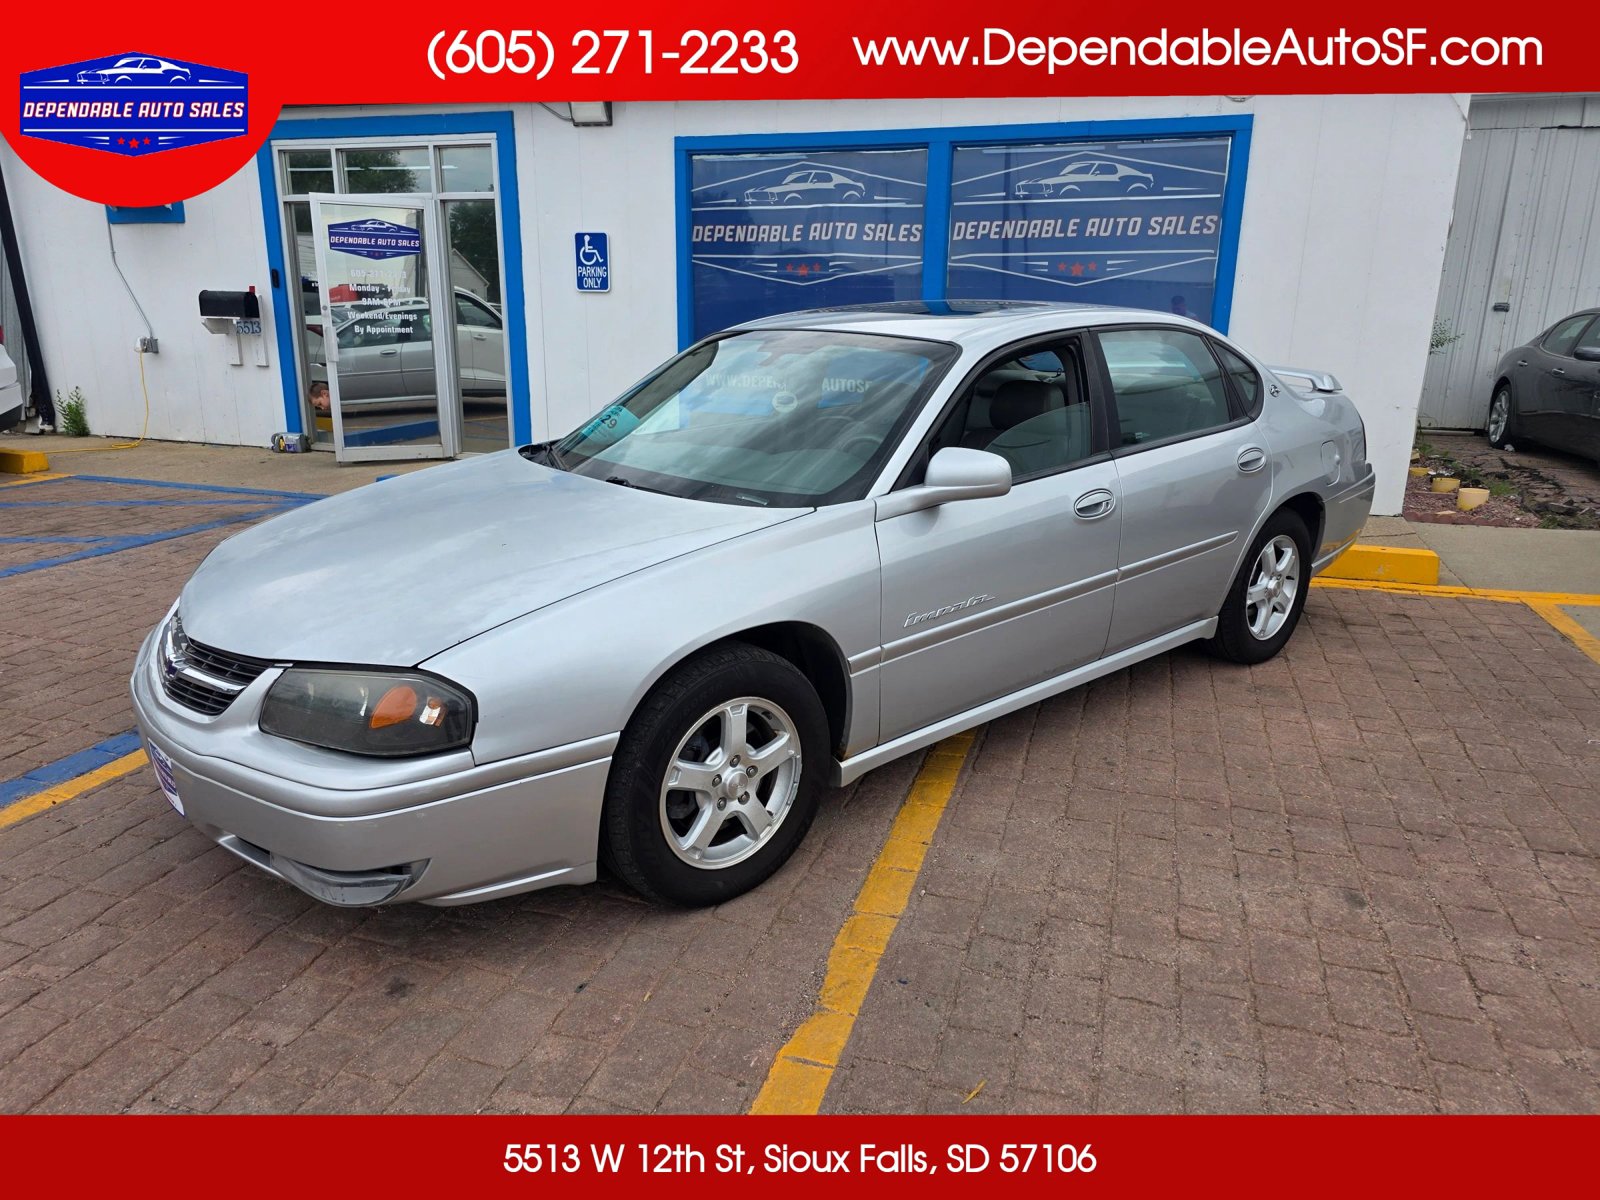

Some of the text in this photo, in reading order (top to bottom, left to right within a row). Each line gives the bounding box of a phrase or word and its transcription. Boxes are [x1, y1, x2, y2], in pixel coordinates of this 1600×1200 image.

[692, 222, 922, 242] DEPENDABLE AUTO SALES
[953, 215, 1218, 240] DEPENDABLE AUTO SALES
[330, 236, 376, 245] DEPENDABLE
[577, 266, 607, 278] PARKING
[583, 277, 602, 288] ONLY
[349, 284, 380, 293] Monday
[236, 321, 261, 335] 5513
[354, 325, 413, 335] By Appointment
